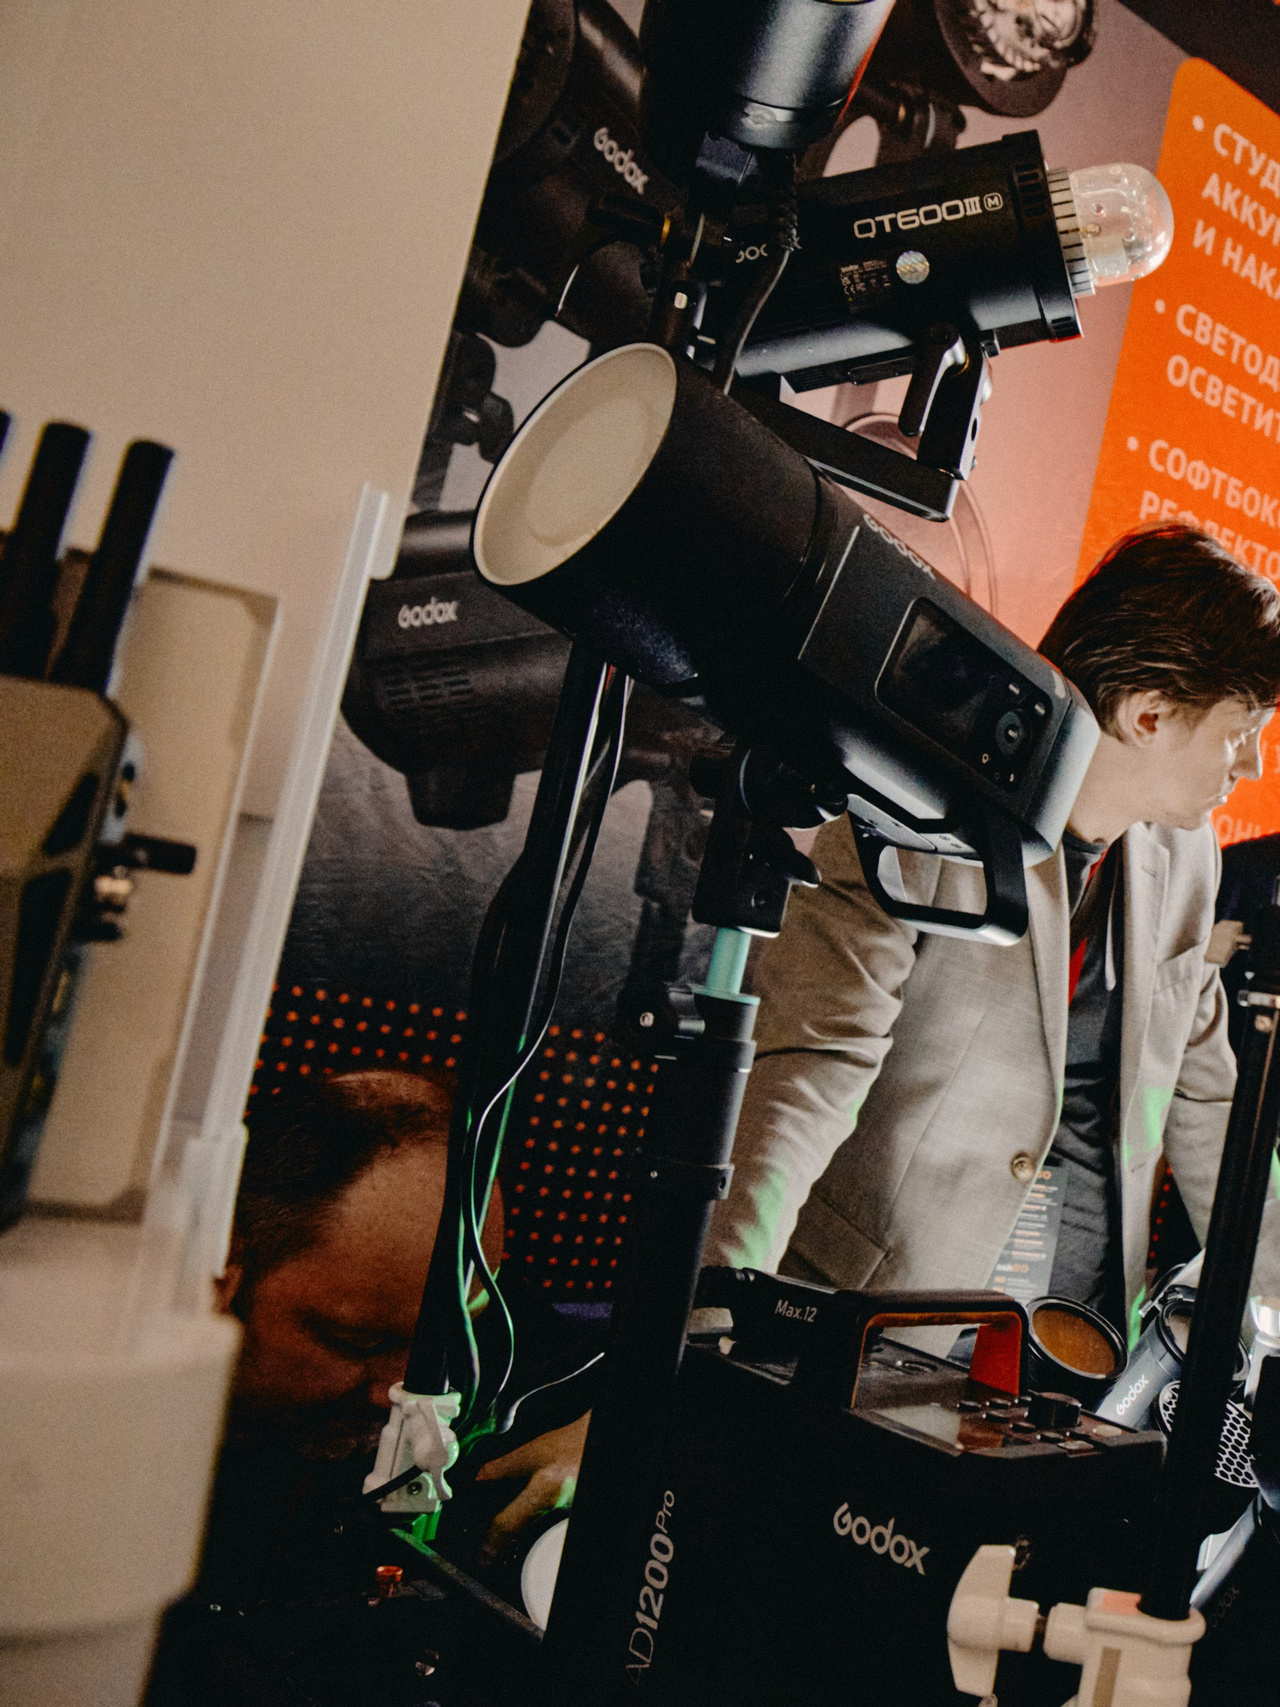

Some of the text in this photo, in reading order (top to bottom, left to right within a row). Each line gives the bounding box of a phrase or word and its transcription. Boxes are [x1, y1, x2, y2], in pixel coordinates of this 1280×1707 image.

[594, 127, 649, 195] Godox
[1192, 219, 1216, 256] И
[398, 596, 459, 629] Godox
[774, 1299, 818, 1323] Max.12
[1116, 1374, 1149, 1416] Godox
[833, 1502, 930, 1575] Godox
